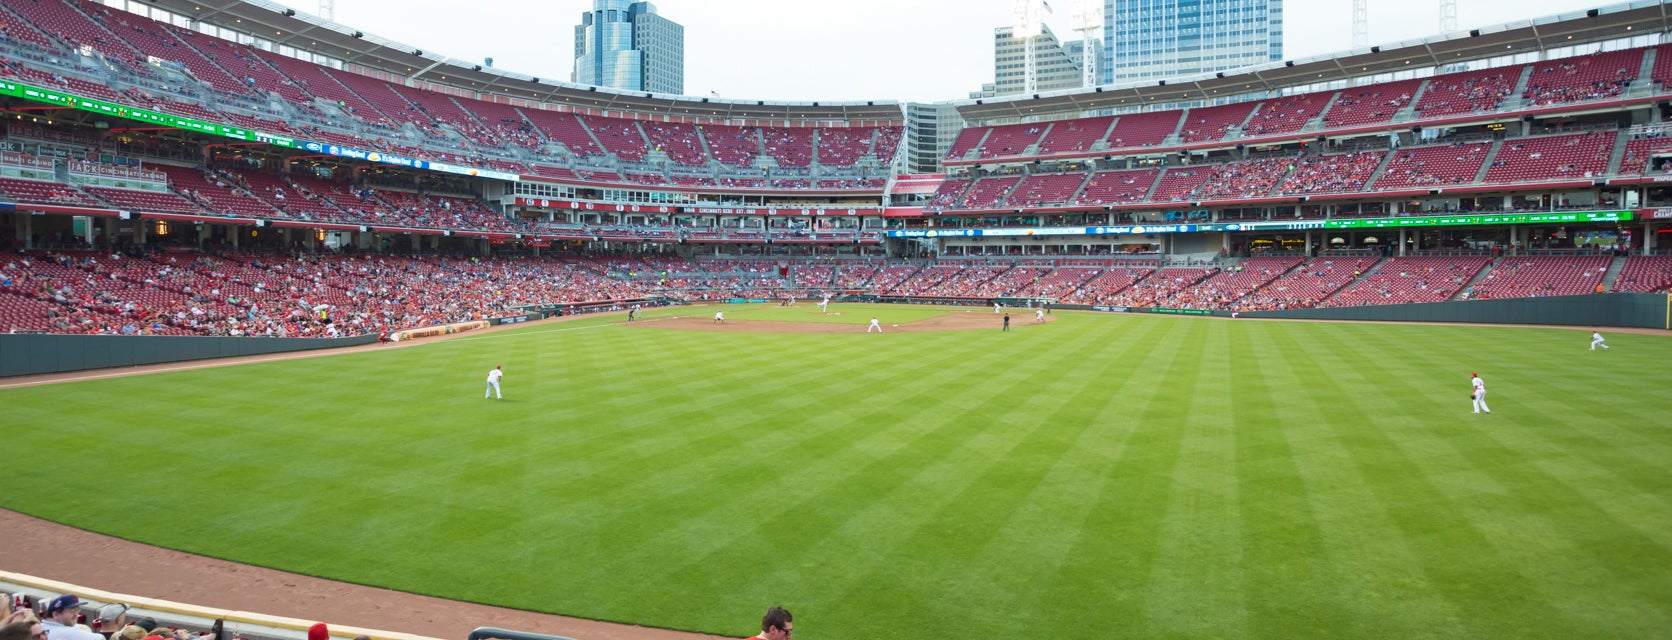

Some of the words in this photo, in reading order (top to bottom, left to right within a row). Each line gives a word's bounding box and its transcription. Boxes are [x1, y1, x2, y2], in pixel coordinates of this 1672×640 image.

[71, 162, 97, 173] JACK
[100, 167, 140, 177] CINCINNATI
[141, 172, 164, 180] CASINO
